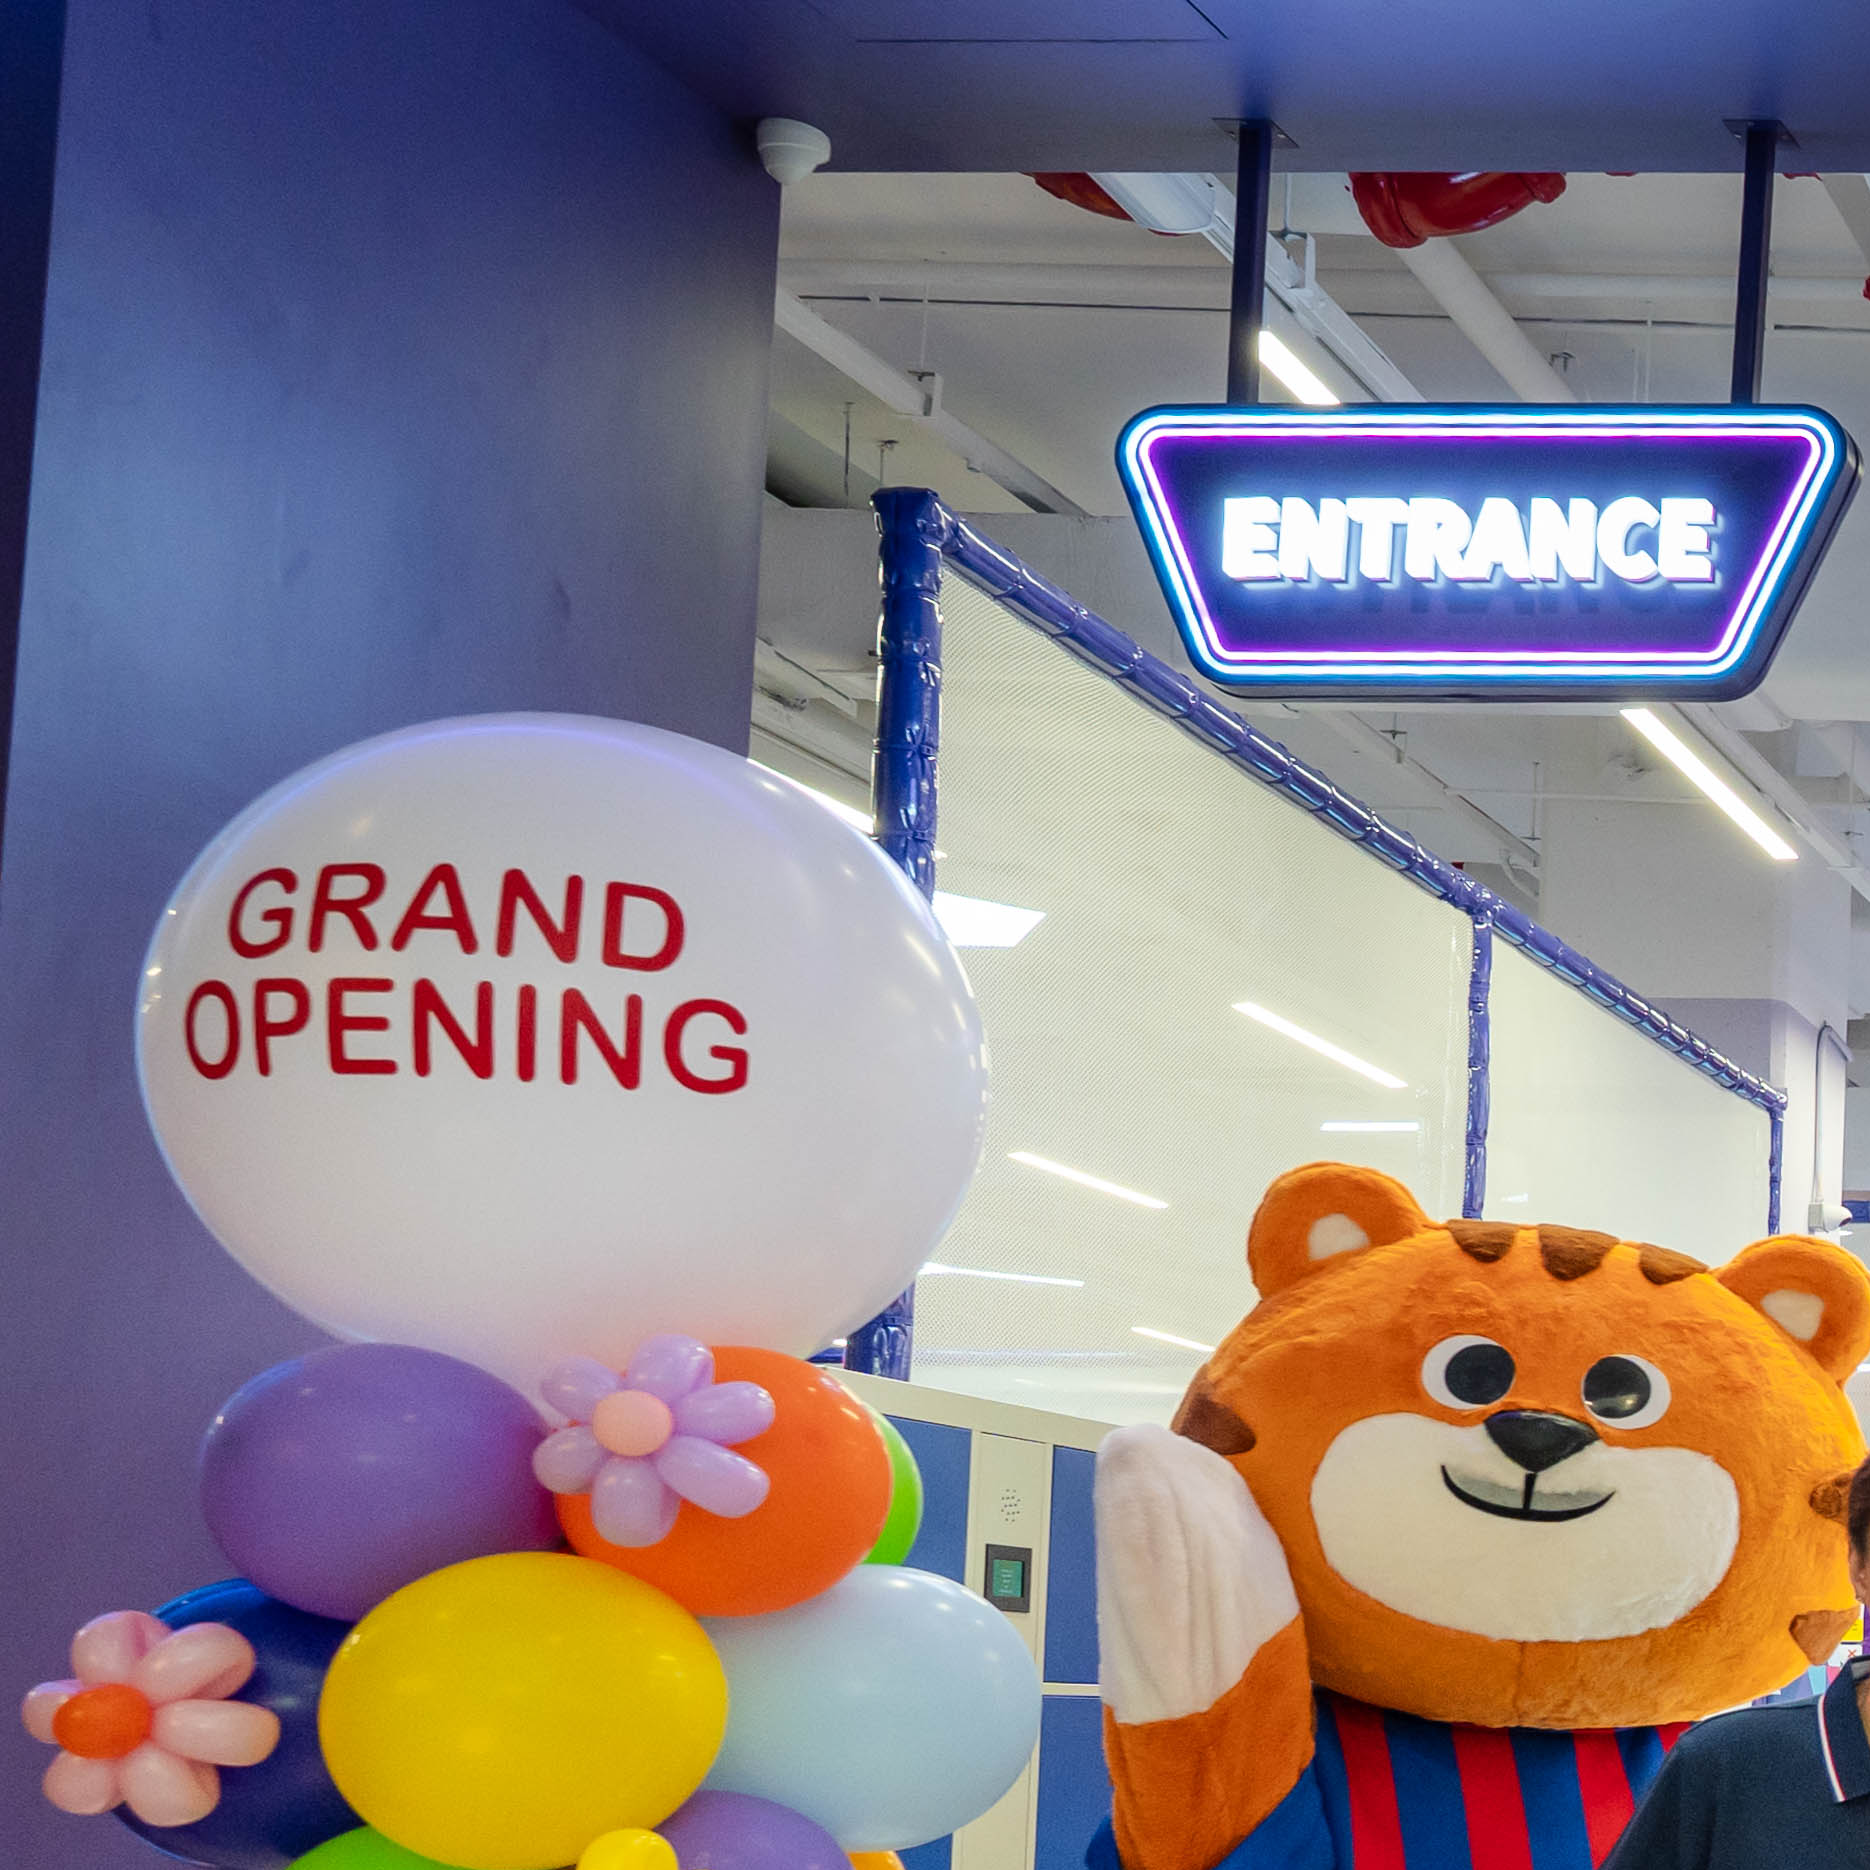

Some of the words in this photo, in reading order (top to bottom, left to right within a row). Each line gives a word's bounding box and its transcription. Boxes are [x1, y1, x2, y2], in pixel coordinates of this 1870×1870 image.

[1221, 496, 1716, 582] ENTRANCE
[228, 862, 686, 972] GRAND
[185, 977, 749, 1095] OPENING
